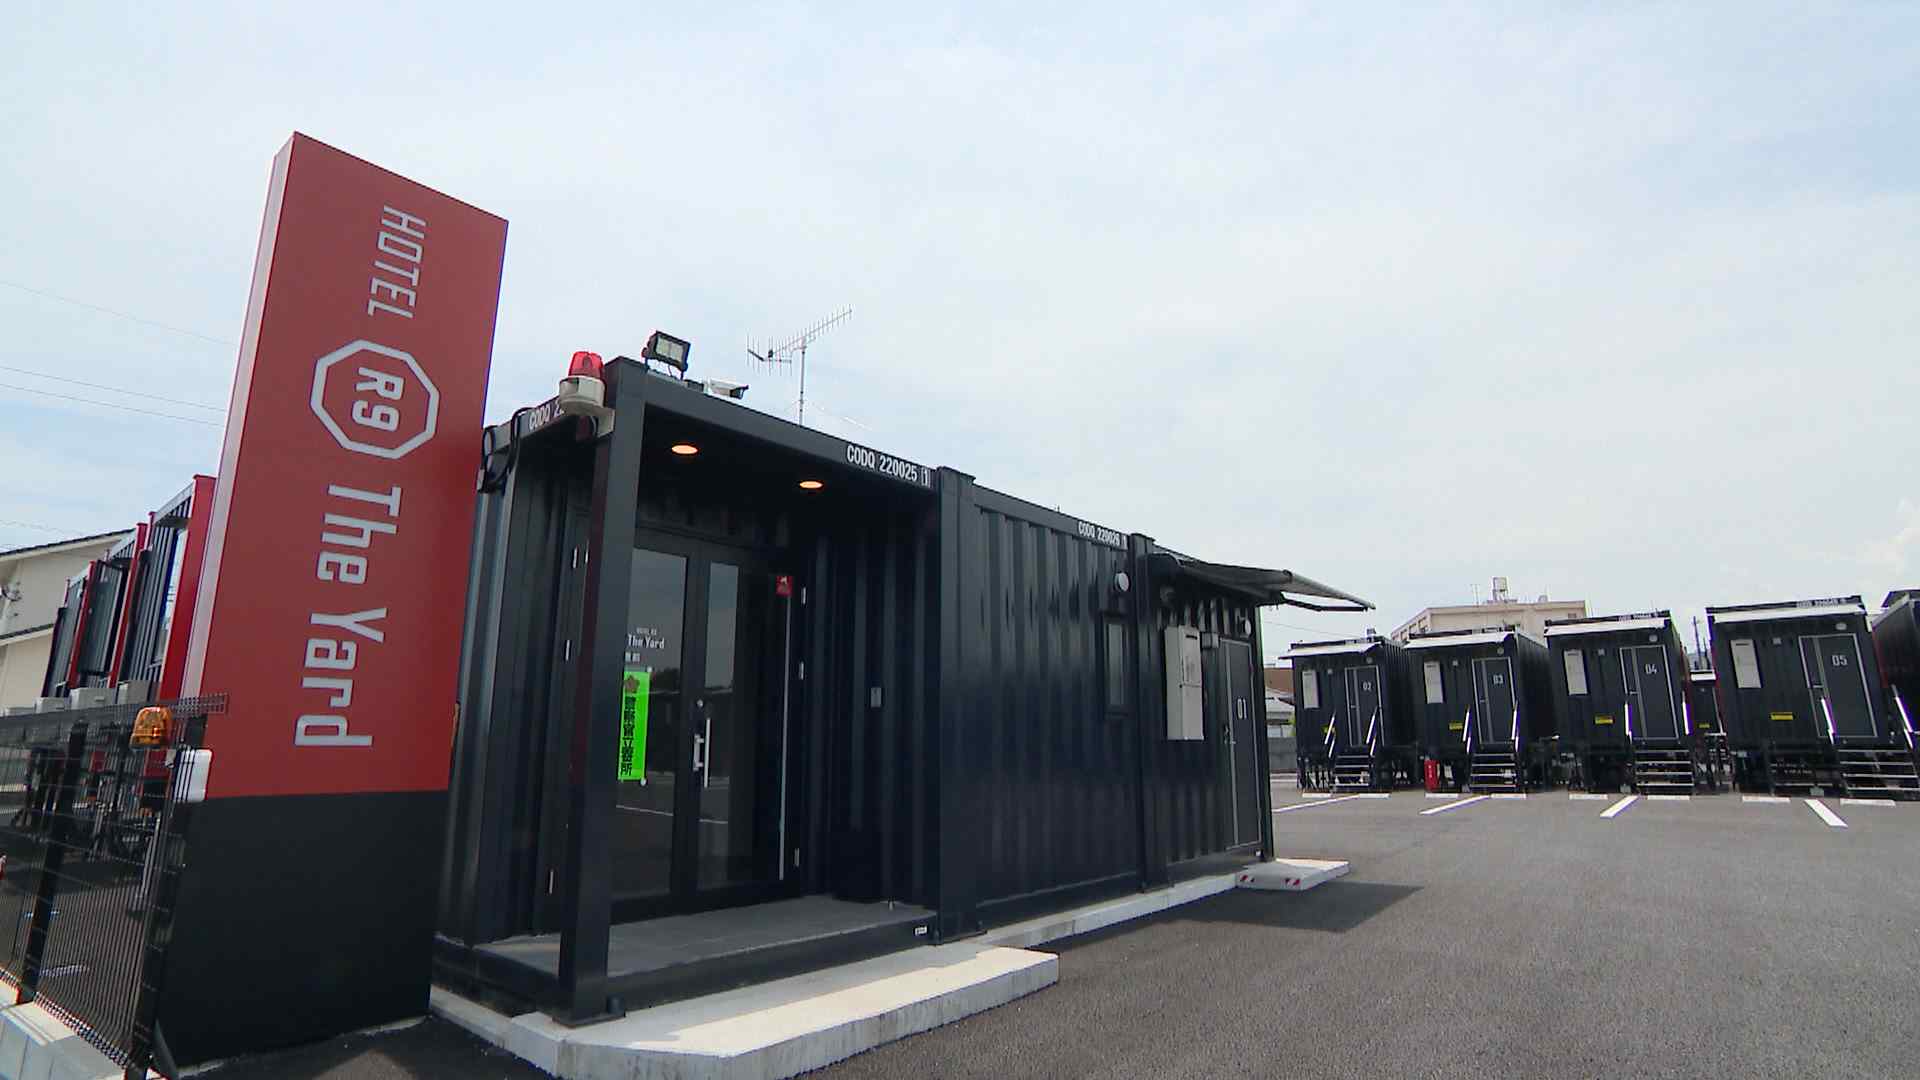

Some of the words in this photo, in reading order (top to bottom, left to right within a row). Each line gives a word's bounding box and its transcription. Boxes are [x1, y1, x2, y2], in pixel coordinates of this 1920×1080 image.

[368, 205, 426, 318] HOTEL
[352, 367, 405, 433] R9
[847, 445, 875, 469] CODQ
[879, 455, 918, 482] 220025
[318, 484, 402, 585] The
[645, 635, 665, 649] Yard
[1832, 655, 1848, 666] 05
[295, 607, 388, 748] Yard
[1645, 663, 1657, 675] 04
[1237, 698, 1247, 720] 01
